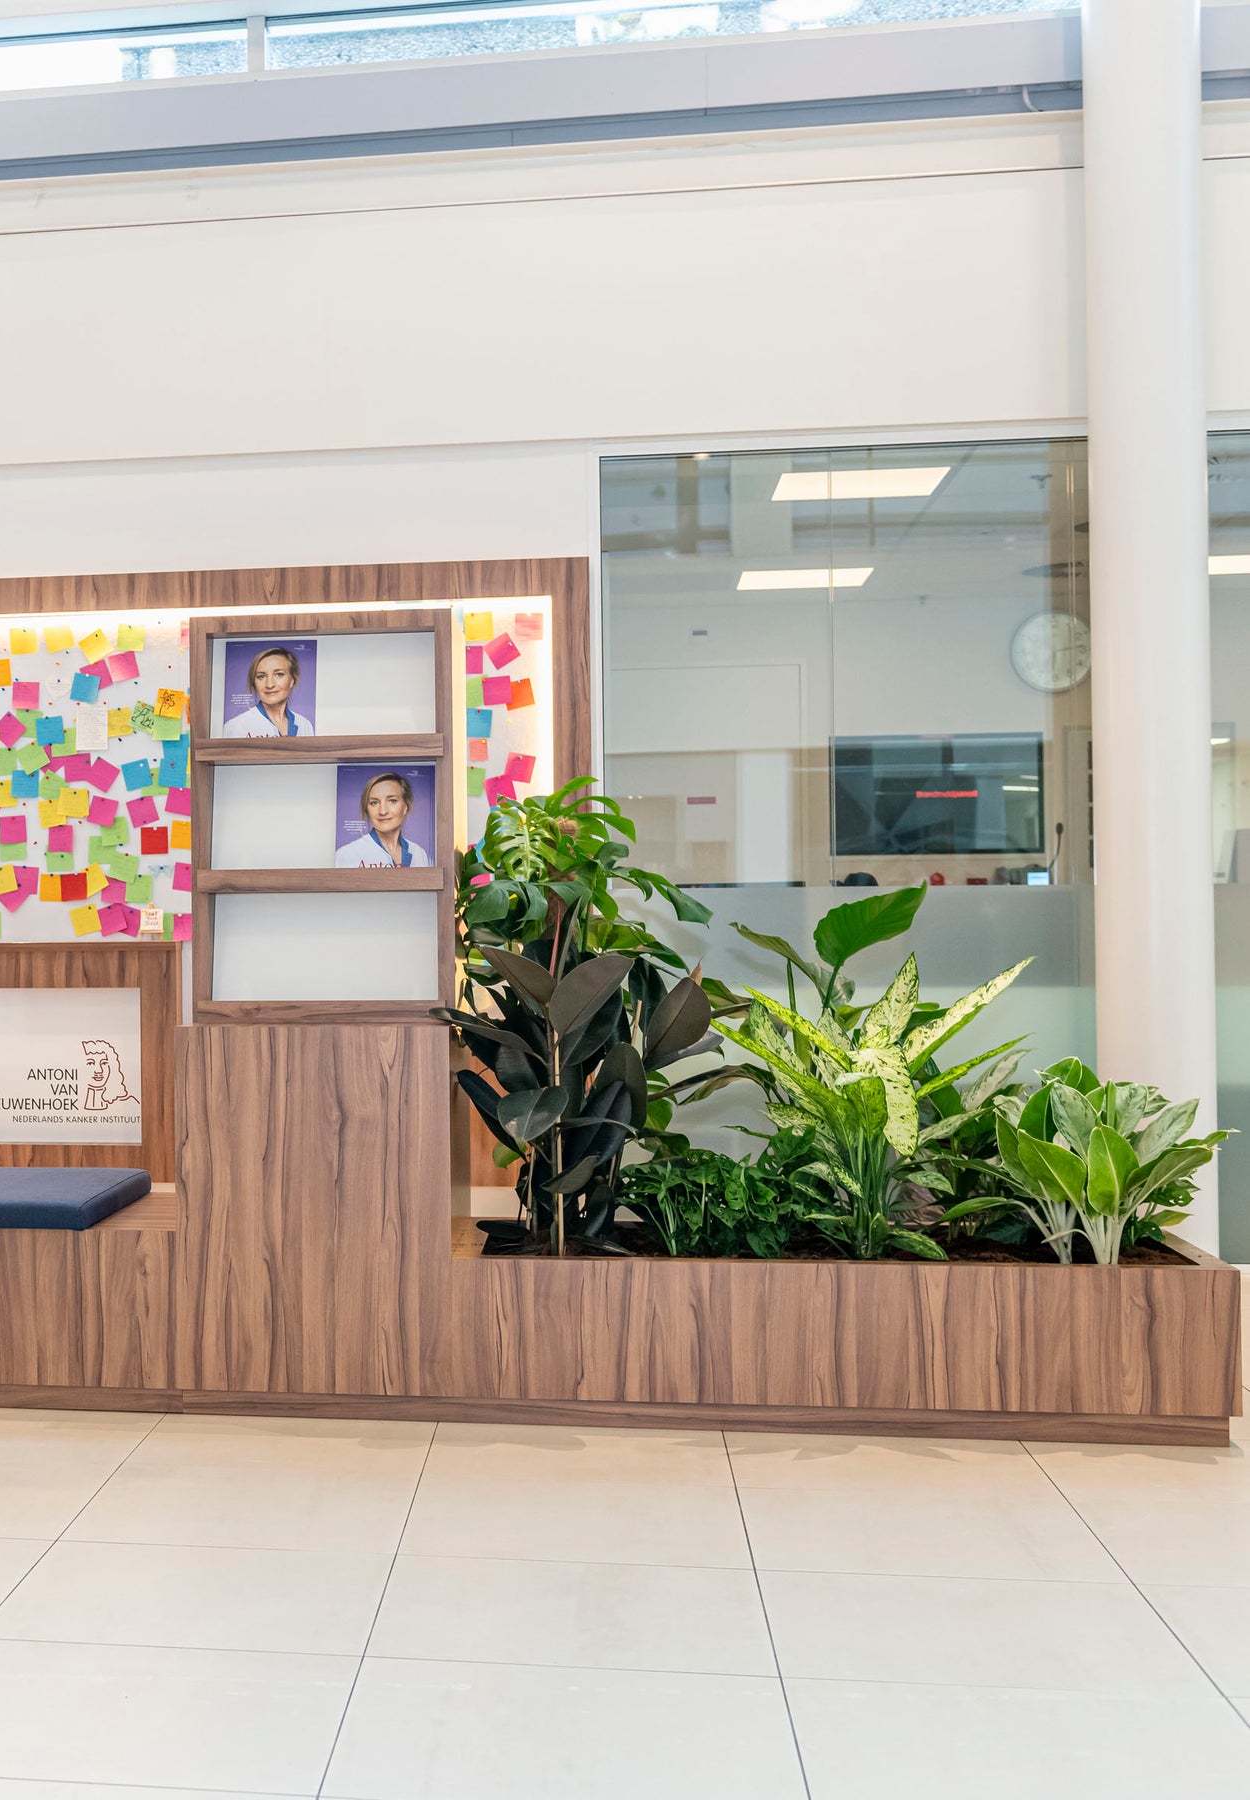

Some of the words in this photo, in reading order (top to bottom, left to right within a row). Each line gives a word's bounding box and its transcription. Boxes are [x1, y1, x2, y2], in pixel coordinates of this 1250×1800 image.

[26, 1068, 78, 1081] ANTONI
[50, 1083, 78, 1096] VAN
[12, 1115, 64, 1123] NEDERLANDS
[65, 1116, 98, 1124] KANKER
[100, 1116, 141, 1124] INSTITUUT
